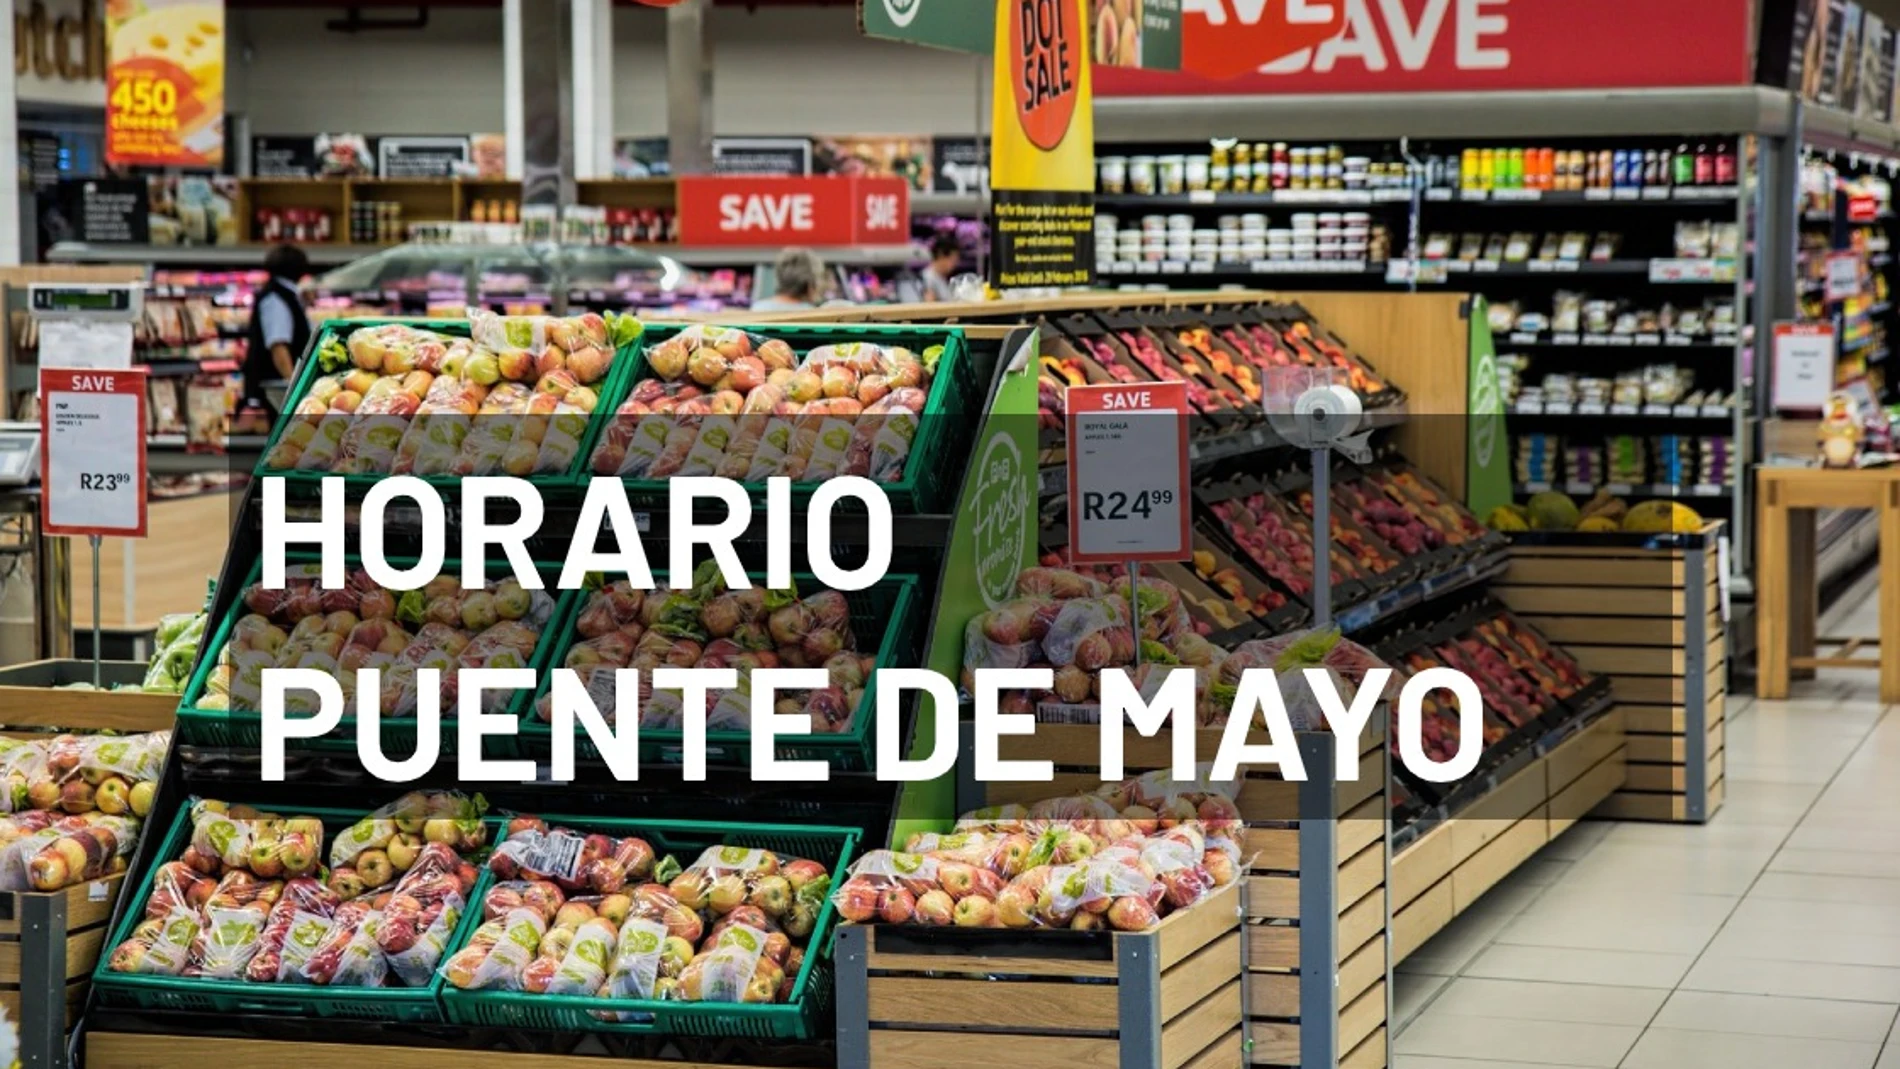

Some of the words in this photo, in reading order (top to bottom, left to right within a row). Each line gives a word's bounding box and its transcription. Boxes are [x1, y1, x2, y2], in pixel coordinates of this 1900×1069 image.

[1258, 0, 1510, 74] AVE
[1023, 42, 1072, 113] SALE
[110, 78, 177, 116] 450
[719, 193, 814, 231] SAVE
[865, 194, 898, 230] SAVE
[71, 375, 115, 392] SAVE
[1102, 391, 1151, 410] SAVE
